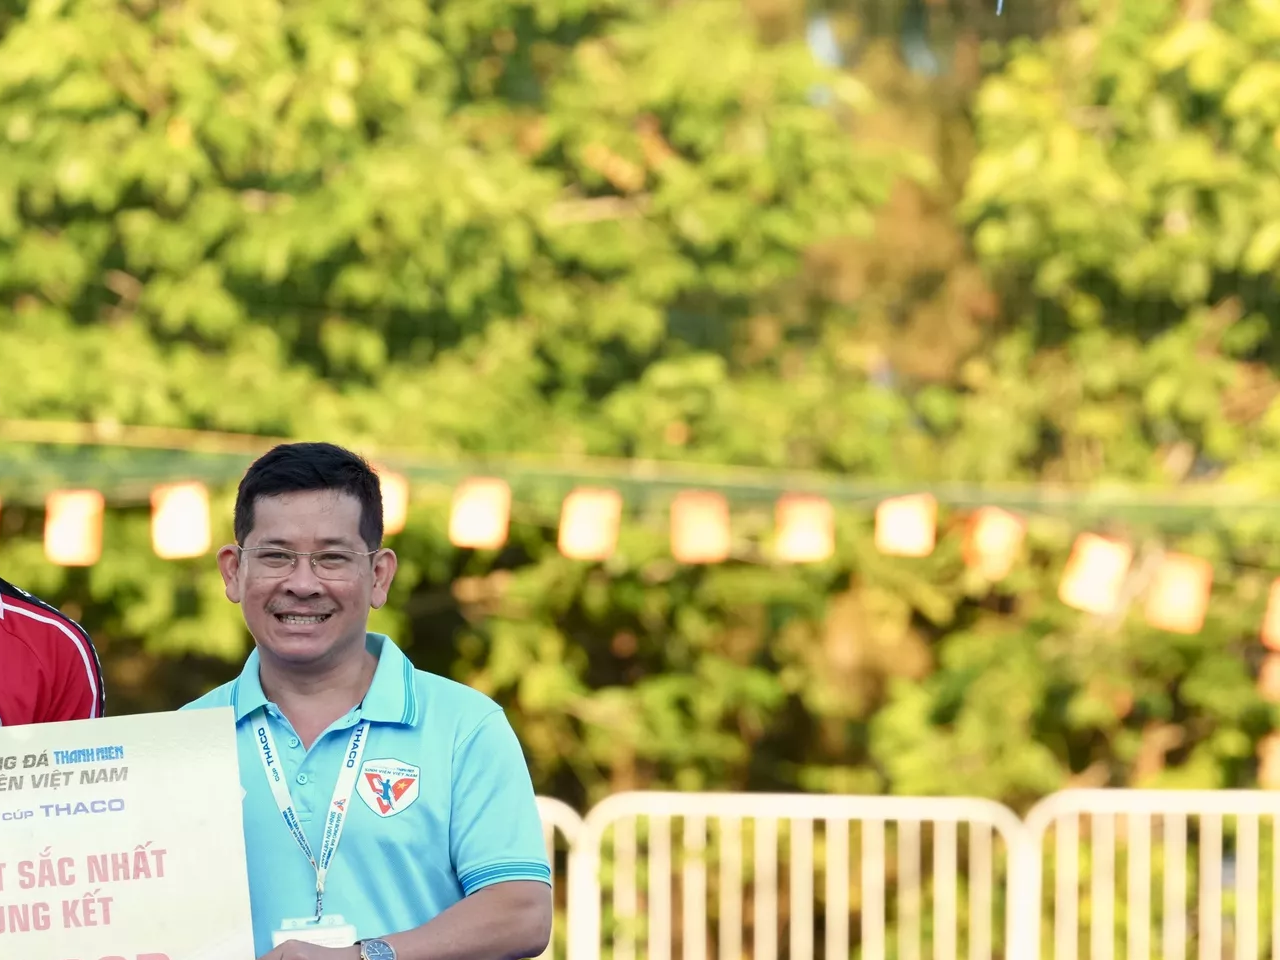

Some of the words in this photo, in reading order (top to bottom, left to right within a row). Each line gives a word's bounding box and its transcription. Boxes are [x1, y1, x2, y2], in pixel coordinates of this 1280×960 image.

[22, 749, 50, 769] ĐÁ
[54, 749, 95, 765] THANH
[257, 727, 274, 767] THACO
[346, 726, 364, 768] THACO
[31, 769, 74, 791] VIỆT
[79, 766, 129, 785] NAM
[2, 808, 34, 821] CÚP
[40, 798, 125, 818] THACO
[17, 845, 77, 891] SẮC
[86, 840, 168, 884] NHẤT
[61, 888, 114, 929] KẾT
